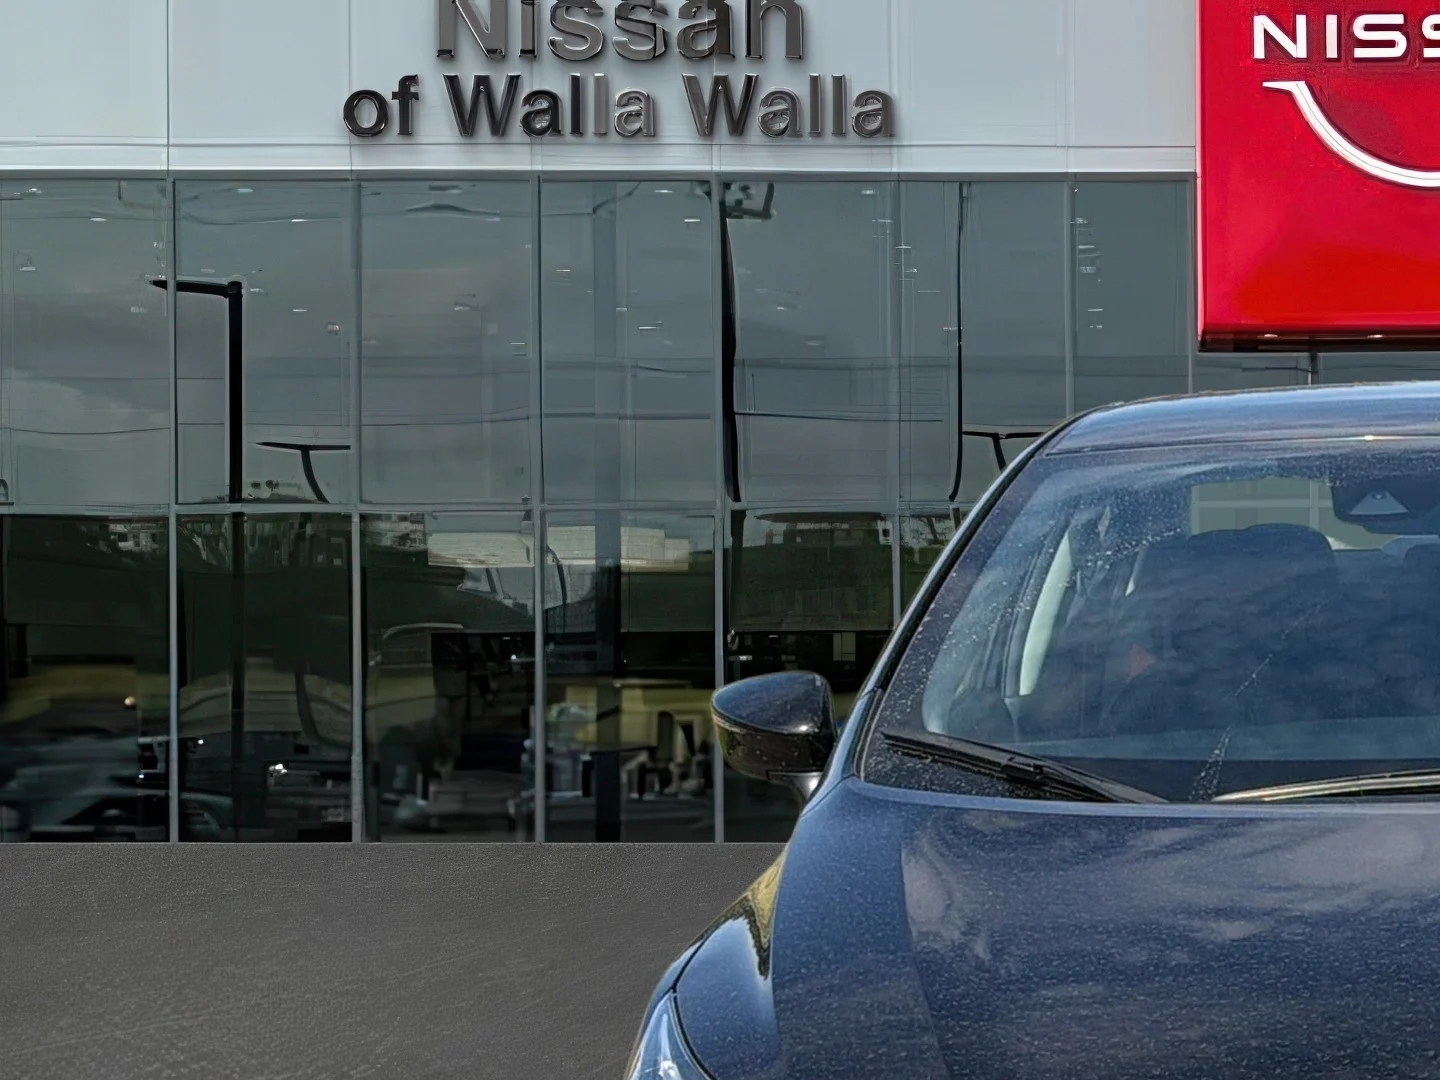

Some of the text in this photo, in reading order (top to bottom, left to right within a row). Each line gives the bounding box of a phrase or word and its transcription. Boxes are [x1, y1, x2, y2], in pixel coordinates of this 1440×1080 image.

[436, 0, 804, 60] Nissan
[343, 73, 895, 137] of Walla Walla
